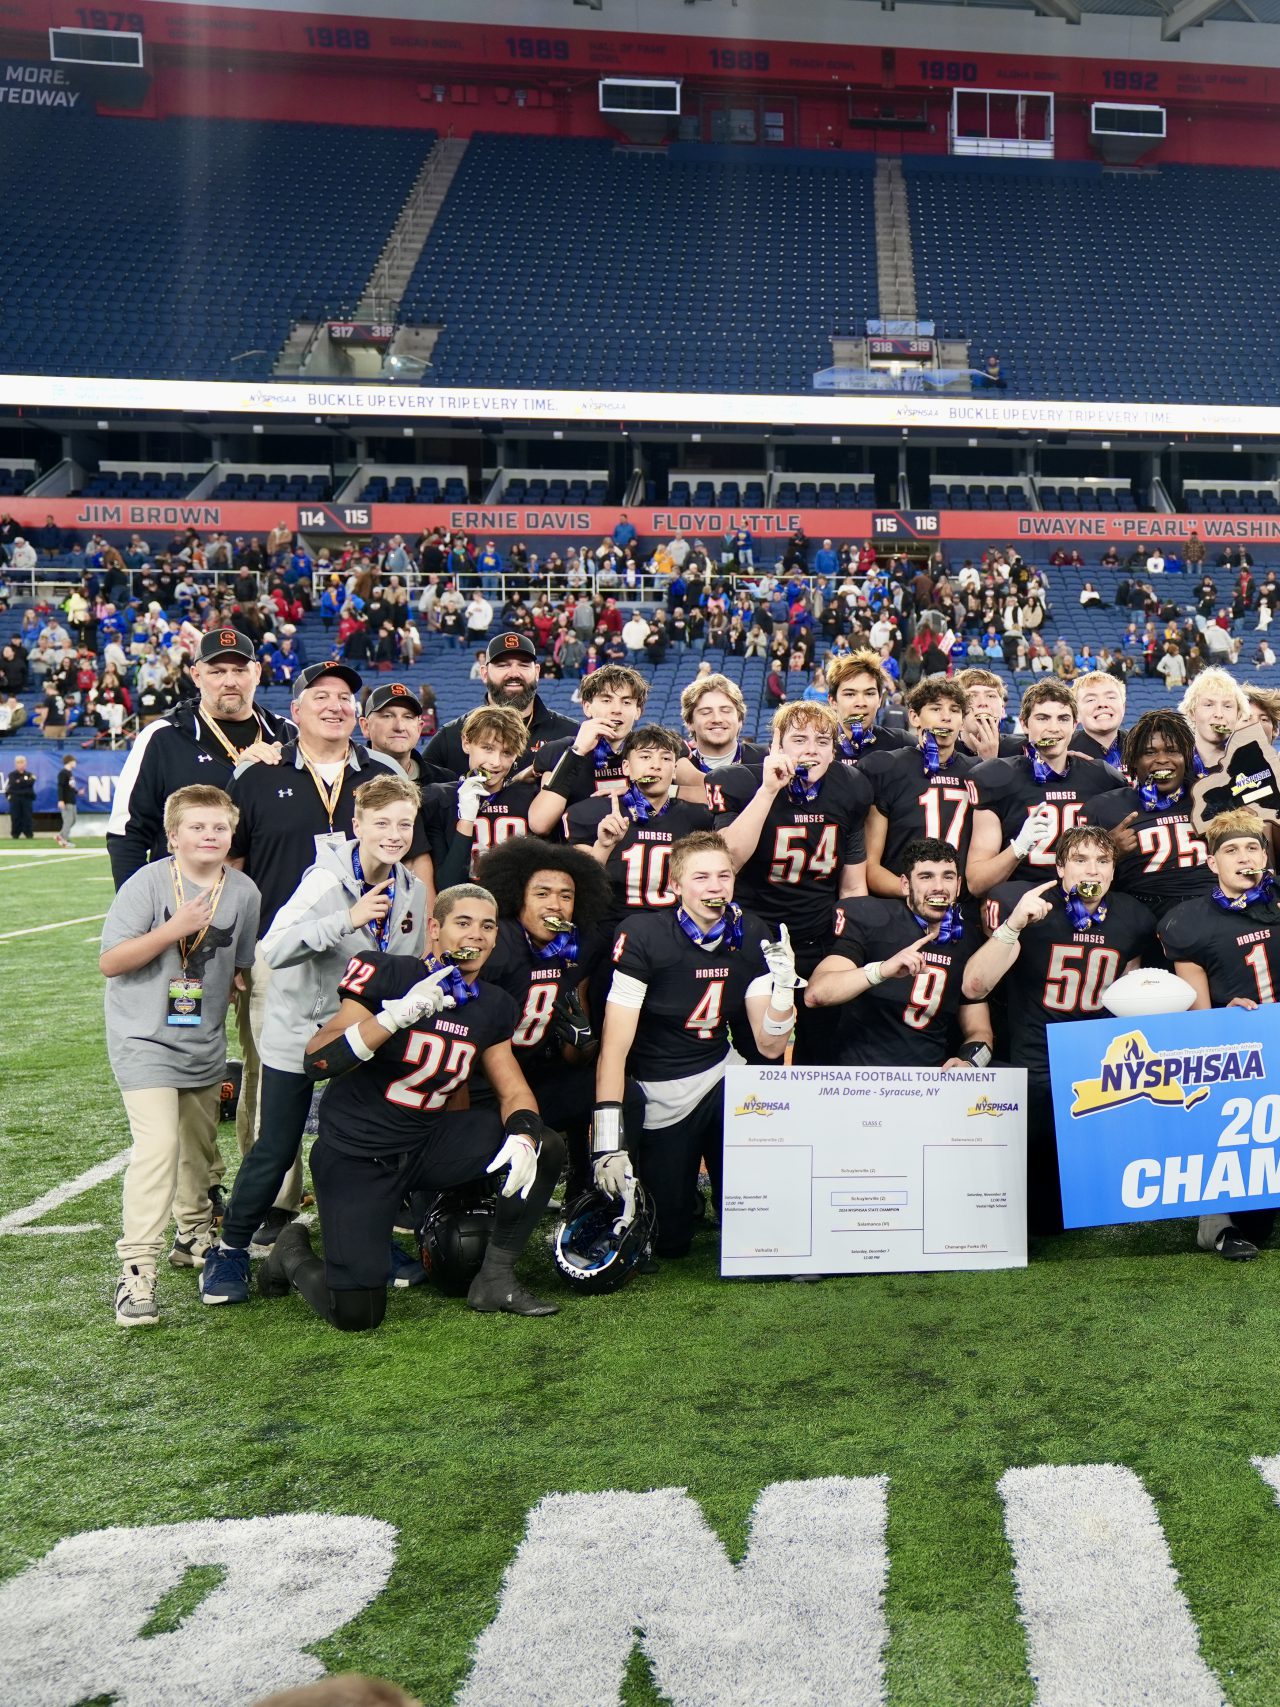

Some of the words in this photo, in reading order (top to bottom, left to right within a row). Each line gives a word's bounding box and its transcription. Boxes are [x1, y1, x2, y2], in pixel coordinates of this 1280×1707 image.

[304, 27, 370, 50] 1988
[505, 37, 569, 61] 1989
[708, 48, 770, 72] 1989
[6, 66, 70, 85] MORE.
[919, 60, 978, 82] 1990
[1102, 70, 1158, 92] 1992
[331, 326, 353, 338] 317
[371, 325, 394, 337] 318
[872, 341, 893, 353] 318
[910, 341, 930, 352] 319
[308, 393, 363, 406] BUCKLE
[389, 396, 433, 409] EVERY
[474, 397, 517, 410] EVERY
[949, 408, 999, 420] BUCKLE
[1022, 409, 1063, 422] EVERY
[1098, 411, 1139, 424] EVERY
[77, 505, 122, 523] JIM
[129, 506, 221, 525] BROWN
[300, 511, 325, 526] 114
[344, 509, 369, 524] 115
[451, 512, 518, 529] ERNIE
[526, 513, 590, 530] DAVIS
[653, 514, 722, 531] FLOYD
[914, 516, 937, 531] 116
[875, 518, 898, 532] 115
[1018, 518, 1106, 535] DWAYNE
[219, 631, 237, 646] S
[504, 634, 520, 649] S
[595, 769, 624, 778] HORSE
[930, 776, 960, 786] HORSES
[1236, 768, 1272, 788] NYSPHSAA
[1046, 791, 1077, 801] HORSES
[794, 814, 825, 824] HORSES
[918, 788, 969, 852] 17
[1156, 814, 1189, 826] HORSES
[638, 830, 673, 842] HORSES
[769, 823, 839, 885] 54
[621, 843, 680, 907] 10
[835, 908, 847, 937] 9
[1072, 932, 1106, 945] HORSES
[1236, 929, 1272, 946] HORSES
[611, 932, 628, 963] 4
[530, 967, 562, 981] HORSES
[695, 966, 730, 979] HORSES
[1042, 943, 1120, 1013] 50
[1246, 943, 1277, 1003] 1
[902, 964, 948, 1030] 9
[511, 982, 560, 1047] 8
[685, 980, 726, 1039] 4
[435, 1018, 470, 1037] HORSES
[759, 1070, 787, 1081] 2024
[790, 1070, 851, 1082] NYSPHSAA
[855, 1071, 912, 1083] FOOTBALL
[914, 1071, 996, 1084] TOURNAMENT
[1100, 1050, 1265, 1093] NYSPHSAA
[818, 1087, 840, 1098] JMA
[842, 1087, 870, 1097] Dome
[879, 1087, 923, 1099] Syracuse,
[925, 1087, 940, 1098] NY
[743, 1101, 790, 1112] NYSPHSAA
[975, 1102, 1019, 1112] NYSPHSAA
